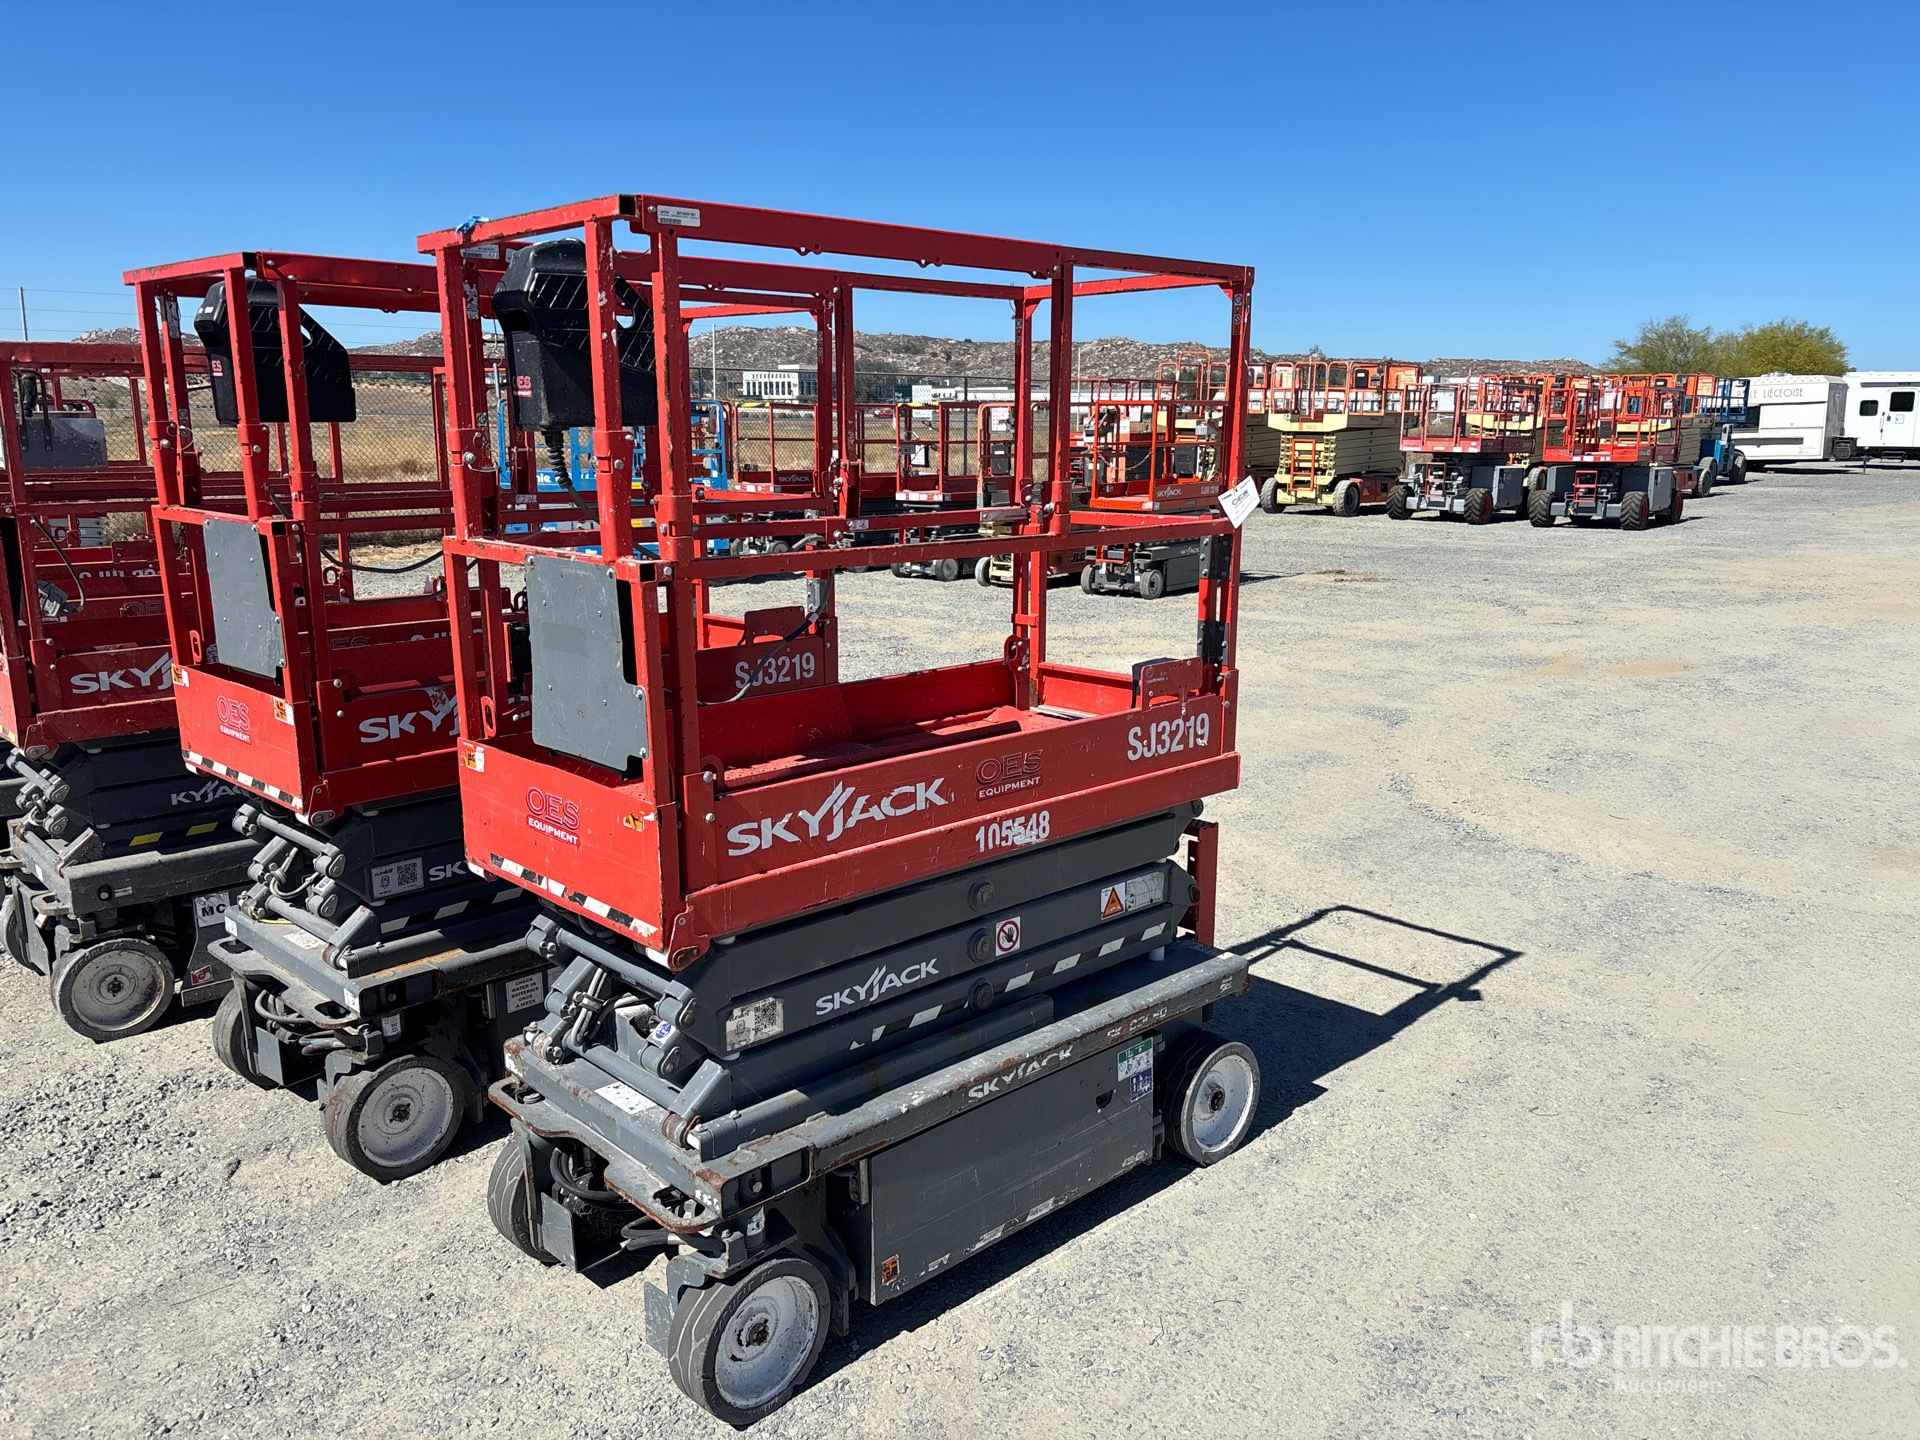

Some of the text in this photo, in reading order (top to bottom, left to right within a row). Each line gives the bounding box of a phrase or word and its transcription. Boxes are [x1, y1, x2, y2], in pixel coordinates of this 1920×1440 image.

[1763, 387, 1803, 398] LIÉGEOISE
[778, 474, 811, 483] SKYJACK
[1156, 486, 1182, 498] SKYJACK
[735, 651, 815, 689] SJ3219
[217, 695, 250, 732] OES
[219, 725, 251, 743] EQUIPMENT
[1127, 712, 1210, 761] SJ3219
[976, 748, 1043, 786] OES
[979, 776, 1041, 798] EQUIPMENT
[526, 786, 580, 831] OES
[726, 777, 949, 857] SKYJACK
[527, 816, 579, 846] EQUIPMENT
[511, 984, 529, 992] WATER
[815, 957, 940, 1016] SKYJACK
